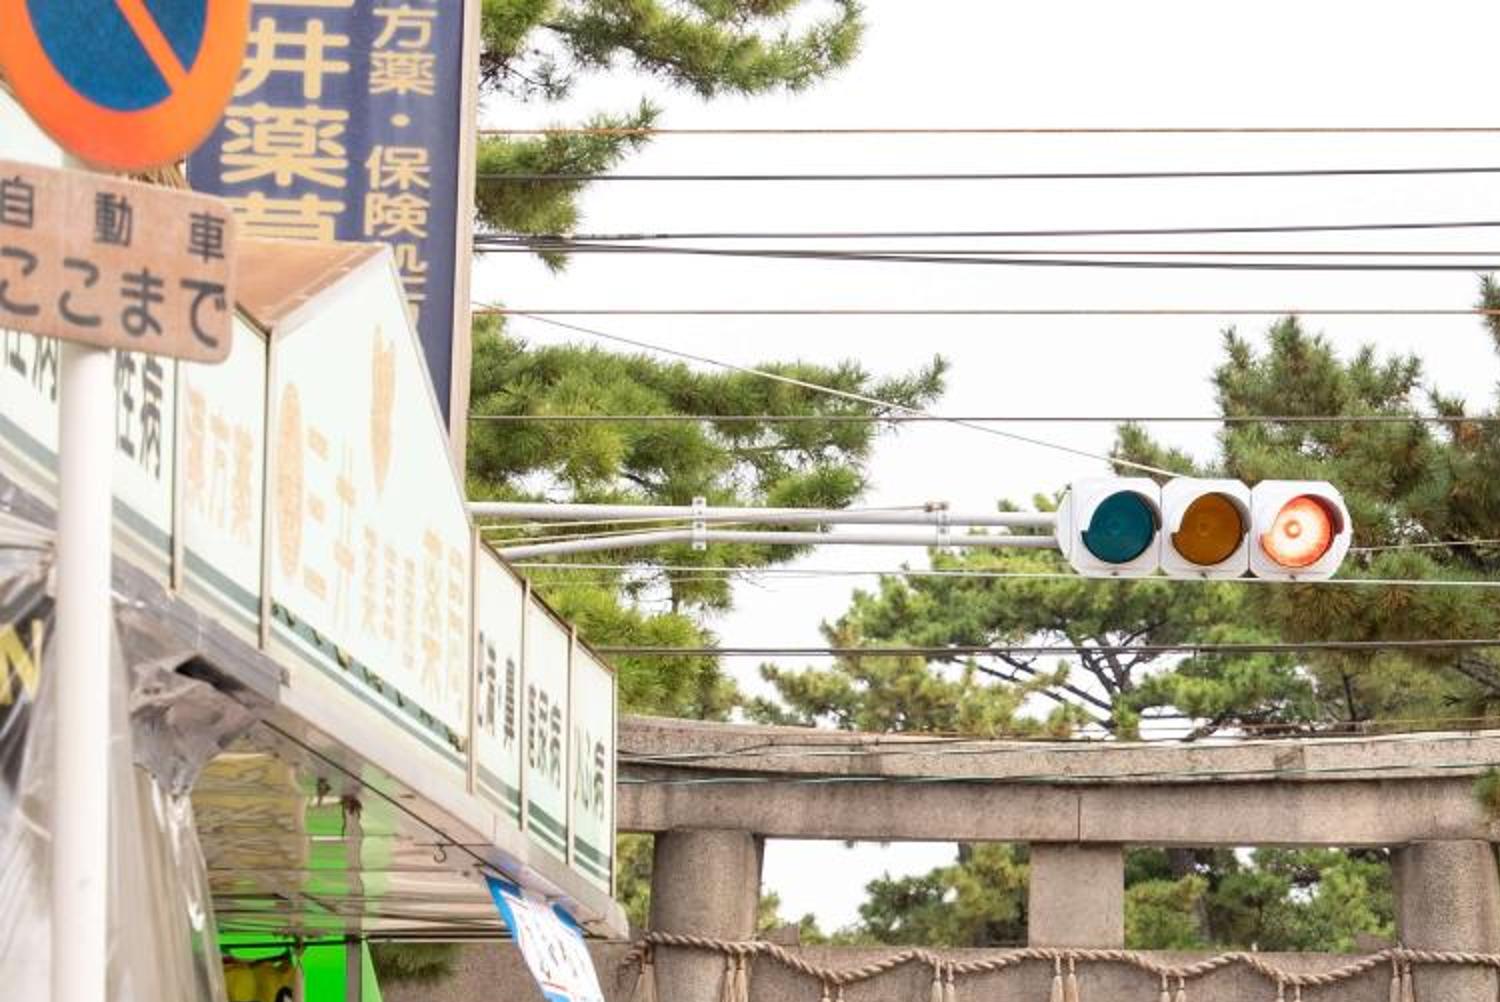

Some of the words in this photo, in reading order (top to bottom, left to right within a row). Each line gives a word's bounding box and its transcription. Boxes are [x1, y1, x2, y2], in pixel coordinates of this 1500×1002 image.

[0, 175, 226, 263] 自動車
[0, 246, 228, 348] ここまで
